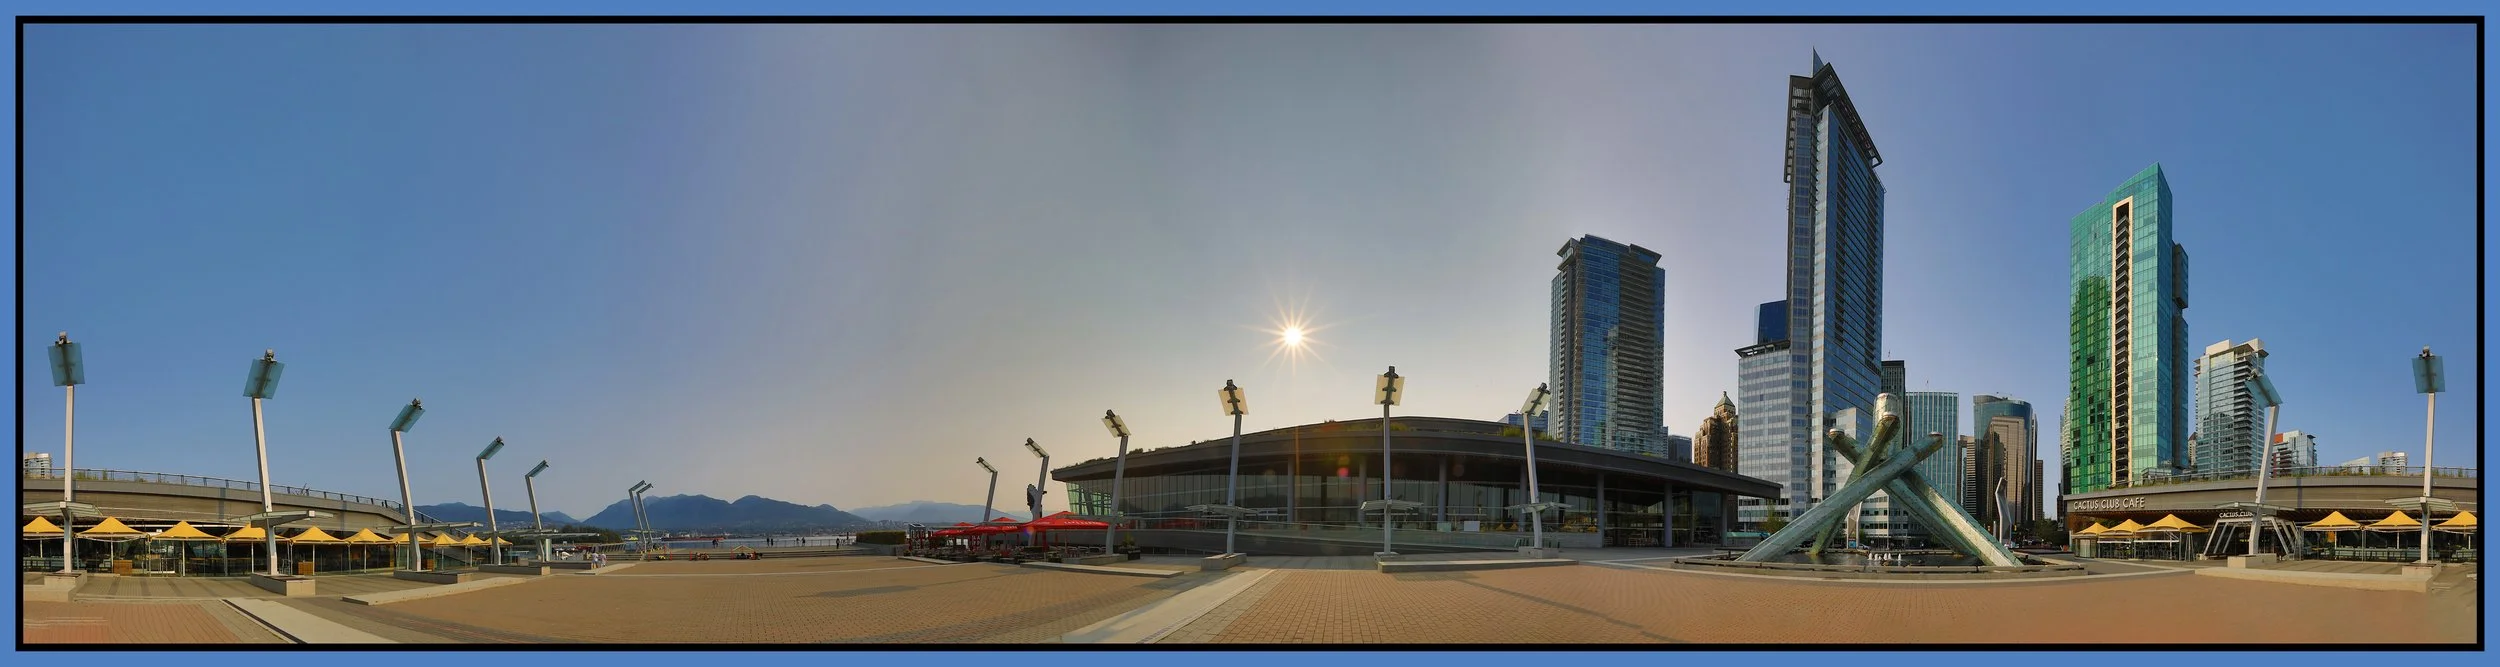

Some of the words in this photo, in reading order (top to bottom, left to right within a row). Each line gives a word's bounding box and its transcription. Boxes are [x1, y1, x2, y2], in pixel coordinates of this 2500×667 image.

[2073, 500, 2099, 510] CACTUS
[2101, 498, 2120, 509] CLUB
[2122, 497, 2145, 508] CAFE
